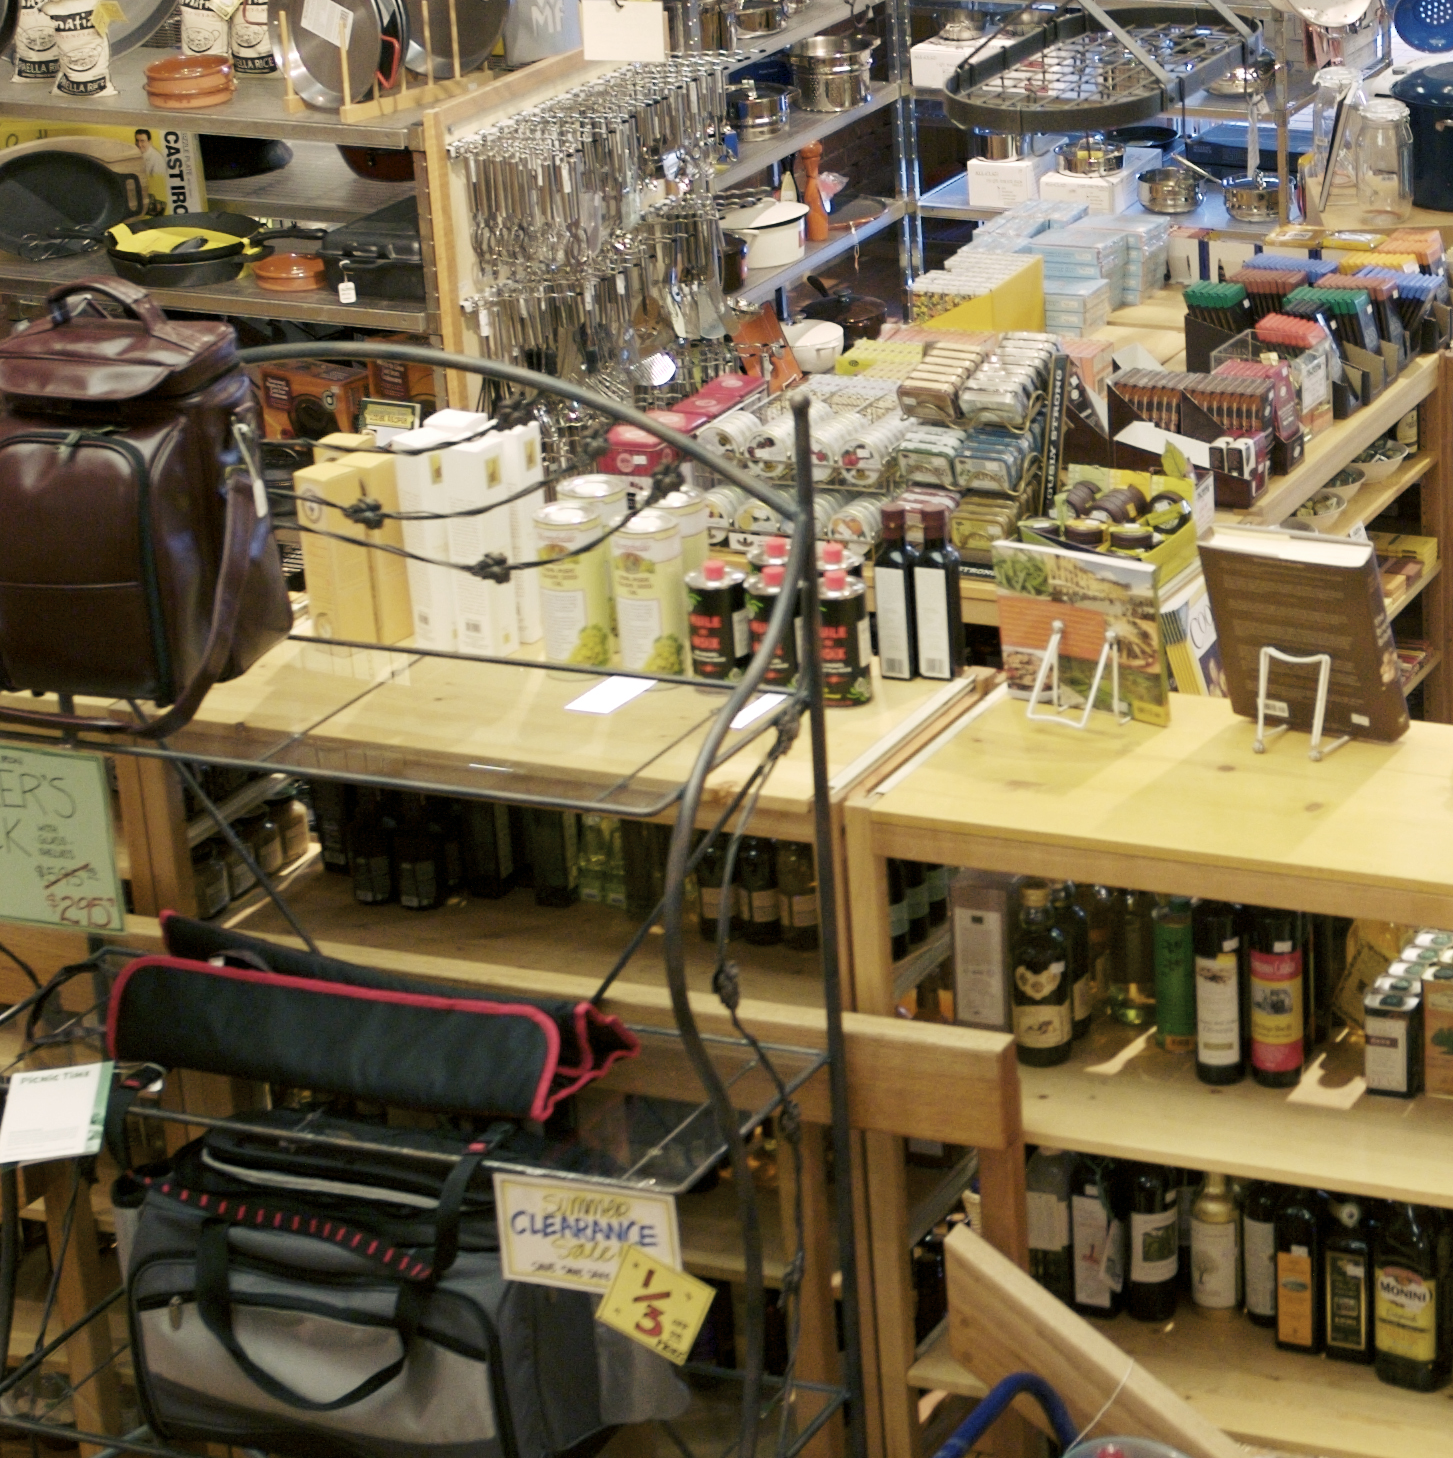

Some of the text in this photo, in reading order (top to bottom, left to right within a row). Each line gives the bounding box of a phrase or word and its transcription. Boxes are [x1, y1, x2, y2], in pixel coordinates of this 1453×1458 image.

[164, 130, 185, 182] CAST
[1050, 369, 1063, 440] STRONG
[511, 1210, 657, 1247] CLEARANCE
[1379, 1279, 1427, 1303] MONINI
